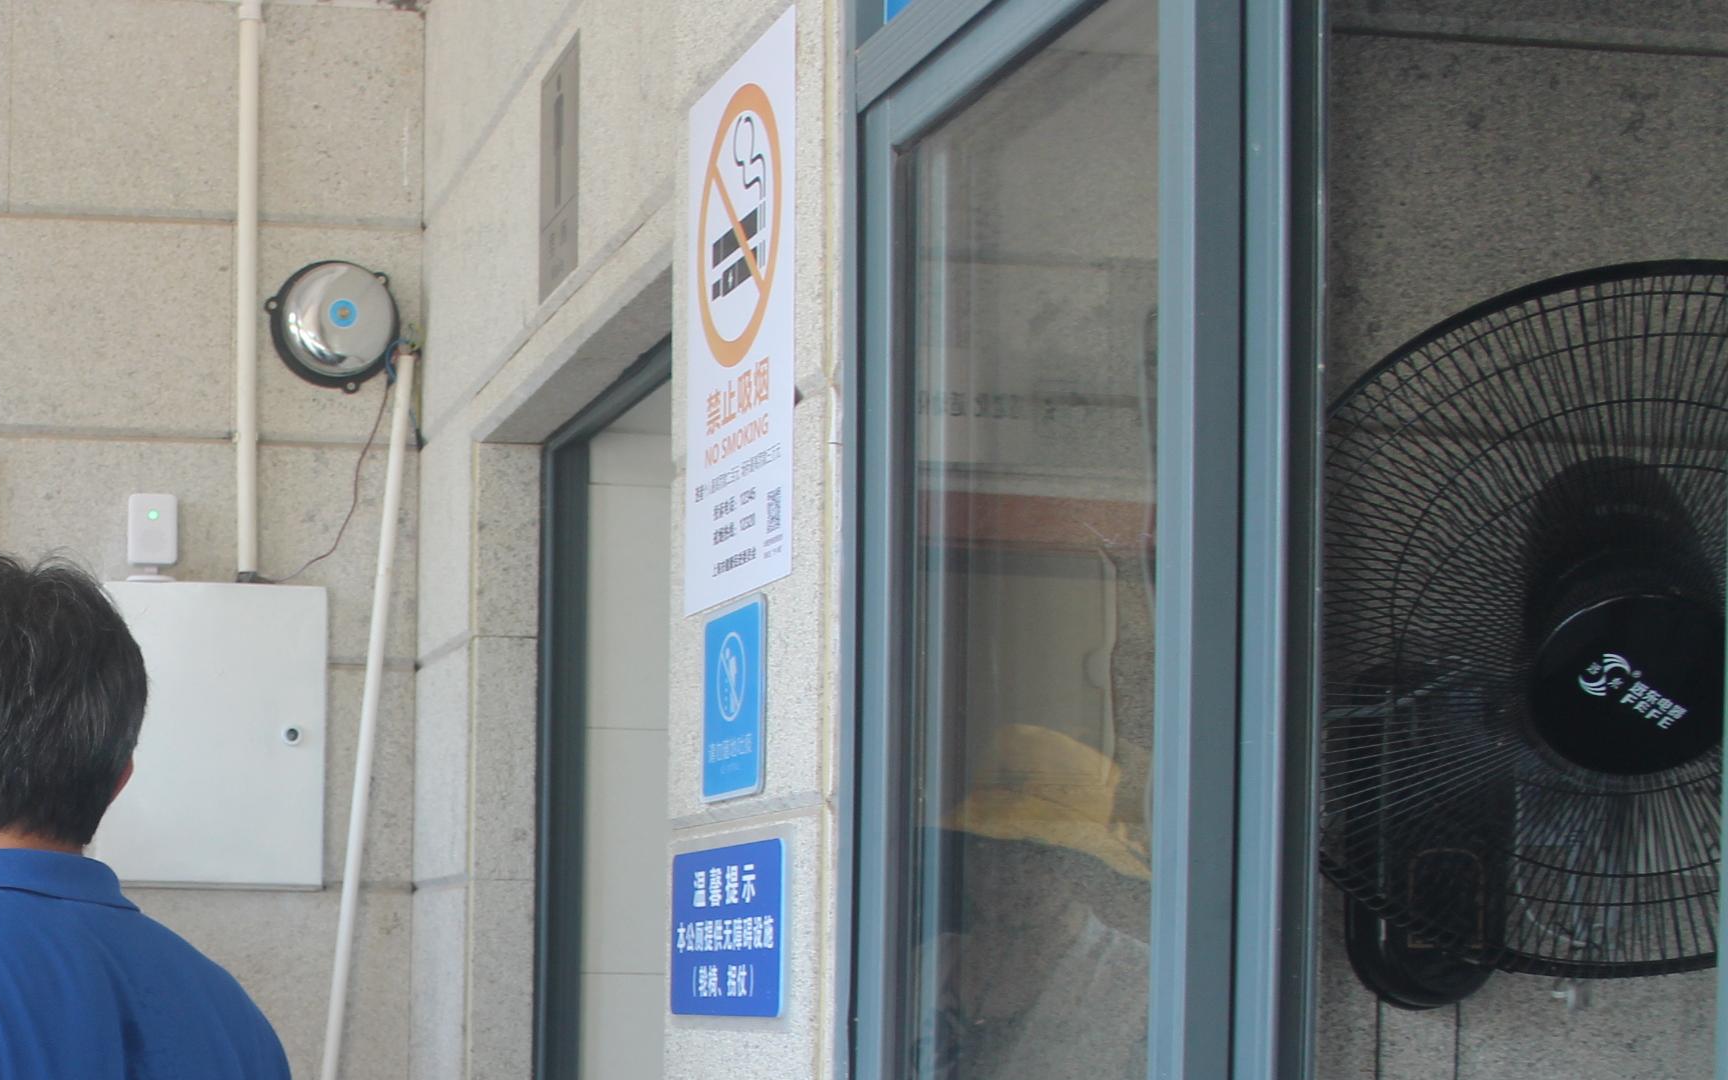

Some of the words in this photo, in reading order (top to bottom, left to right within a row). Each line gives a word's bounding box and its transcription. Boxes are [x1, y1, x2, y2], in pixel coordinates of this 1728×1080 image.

[704, 443, 720, 468] NO
[721, 412, 769, 459] SMOKING
[1619, 692, 1675, 730] FEFE
[692, 864, 757, 908] 温馨提示
